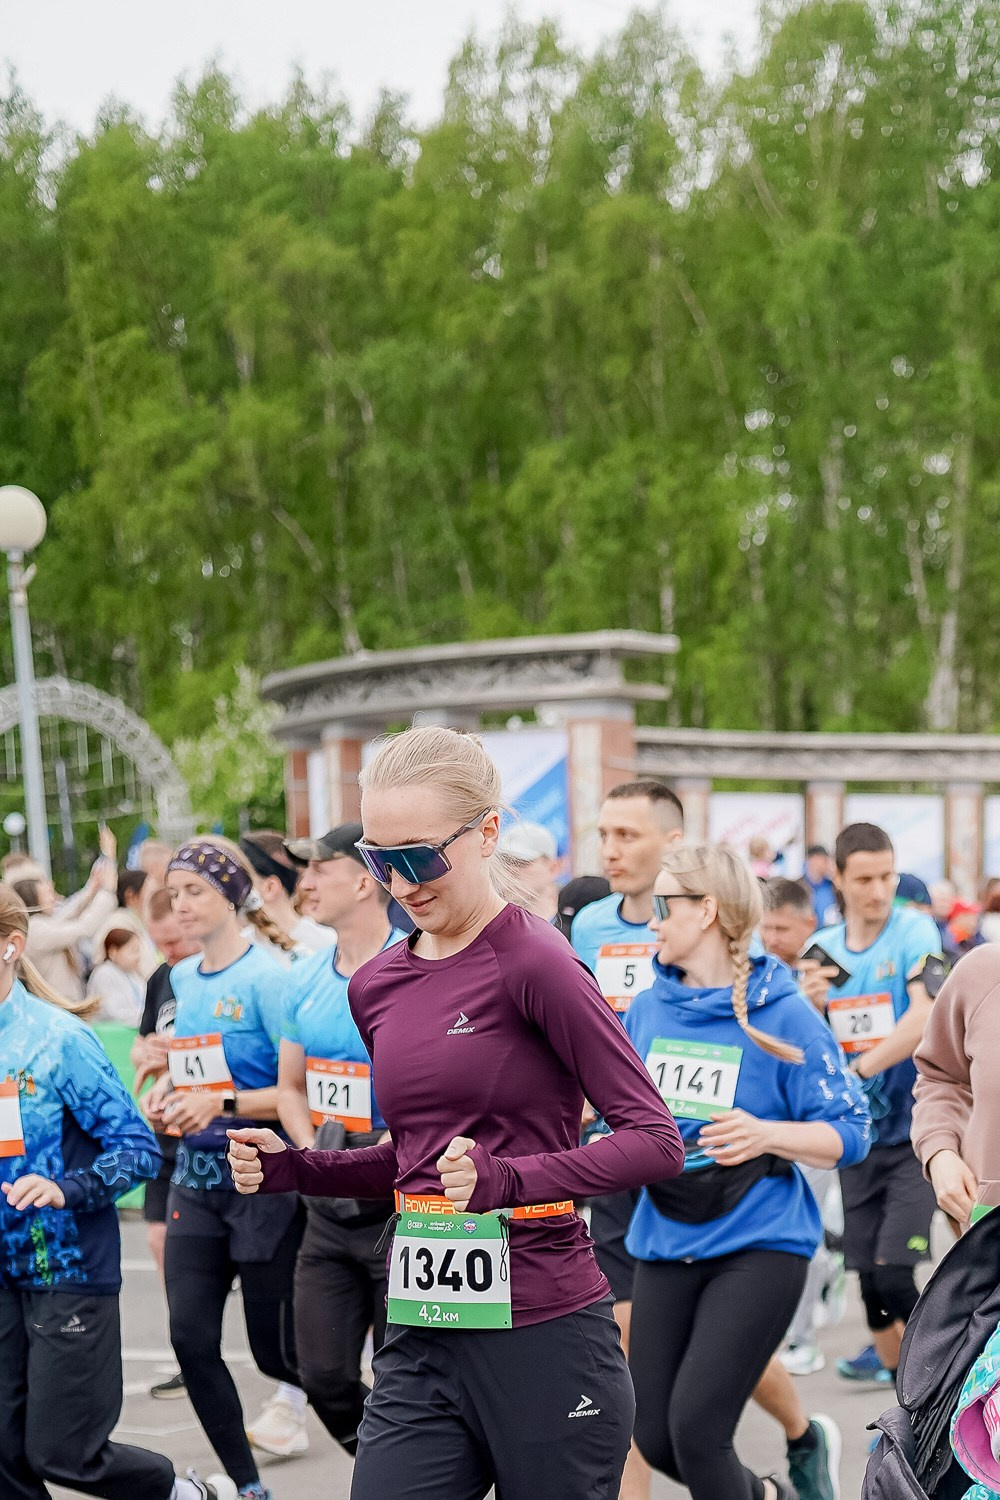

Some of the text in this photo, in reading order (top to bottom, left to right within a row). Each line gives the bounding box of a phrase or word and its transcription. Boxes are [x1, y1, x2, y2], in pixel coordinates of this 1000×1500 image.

[623, 964, 637, 988] 5
[446, 1026, 476, 1036] DEMIX
[848, 1013, 873, 1034] 20
[184, 1055, 206, 1079] 41
[656, 1062, 723, 1098] 1141
[316, 1080, 352, 1110] 121
[399, 1245, 494, 1293] 1340
[567, 1408, 602, 1418] DEMIX
